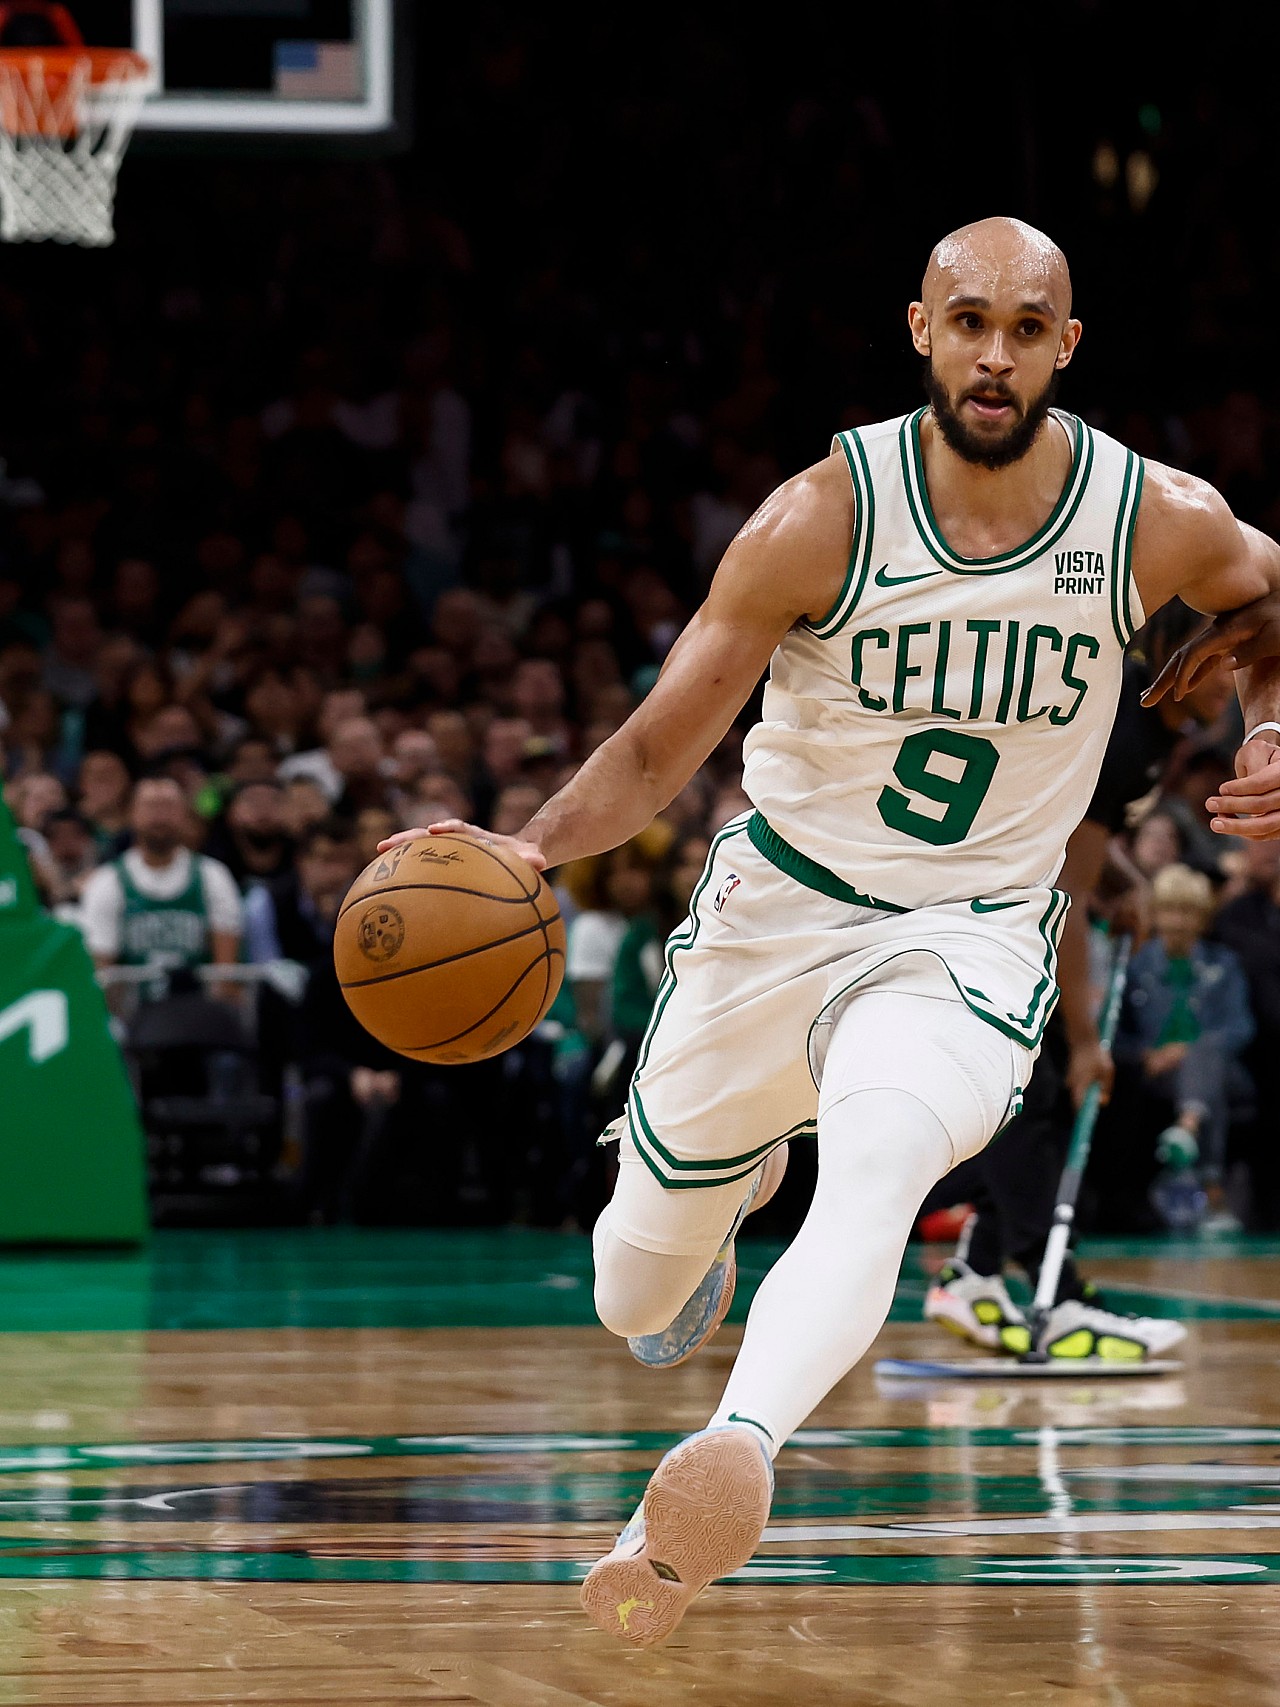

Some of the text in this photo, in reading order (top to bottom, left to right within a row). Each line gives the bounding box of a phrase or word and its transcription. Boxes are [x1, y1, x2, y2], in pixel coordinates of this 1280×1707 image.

[1054, 551, 1105, 576] VISTA
[1054, 577, 1105, 595] PRINT
[851, 620, 1100, 726] CELTICS
[877, 728, 1000, 846] 9
